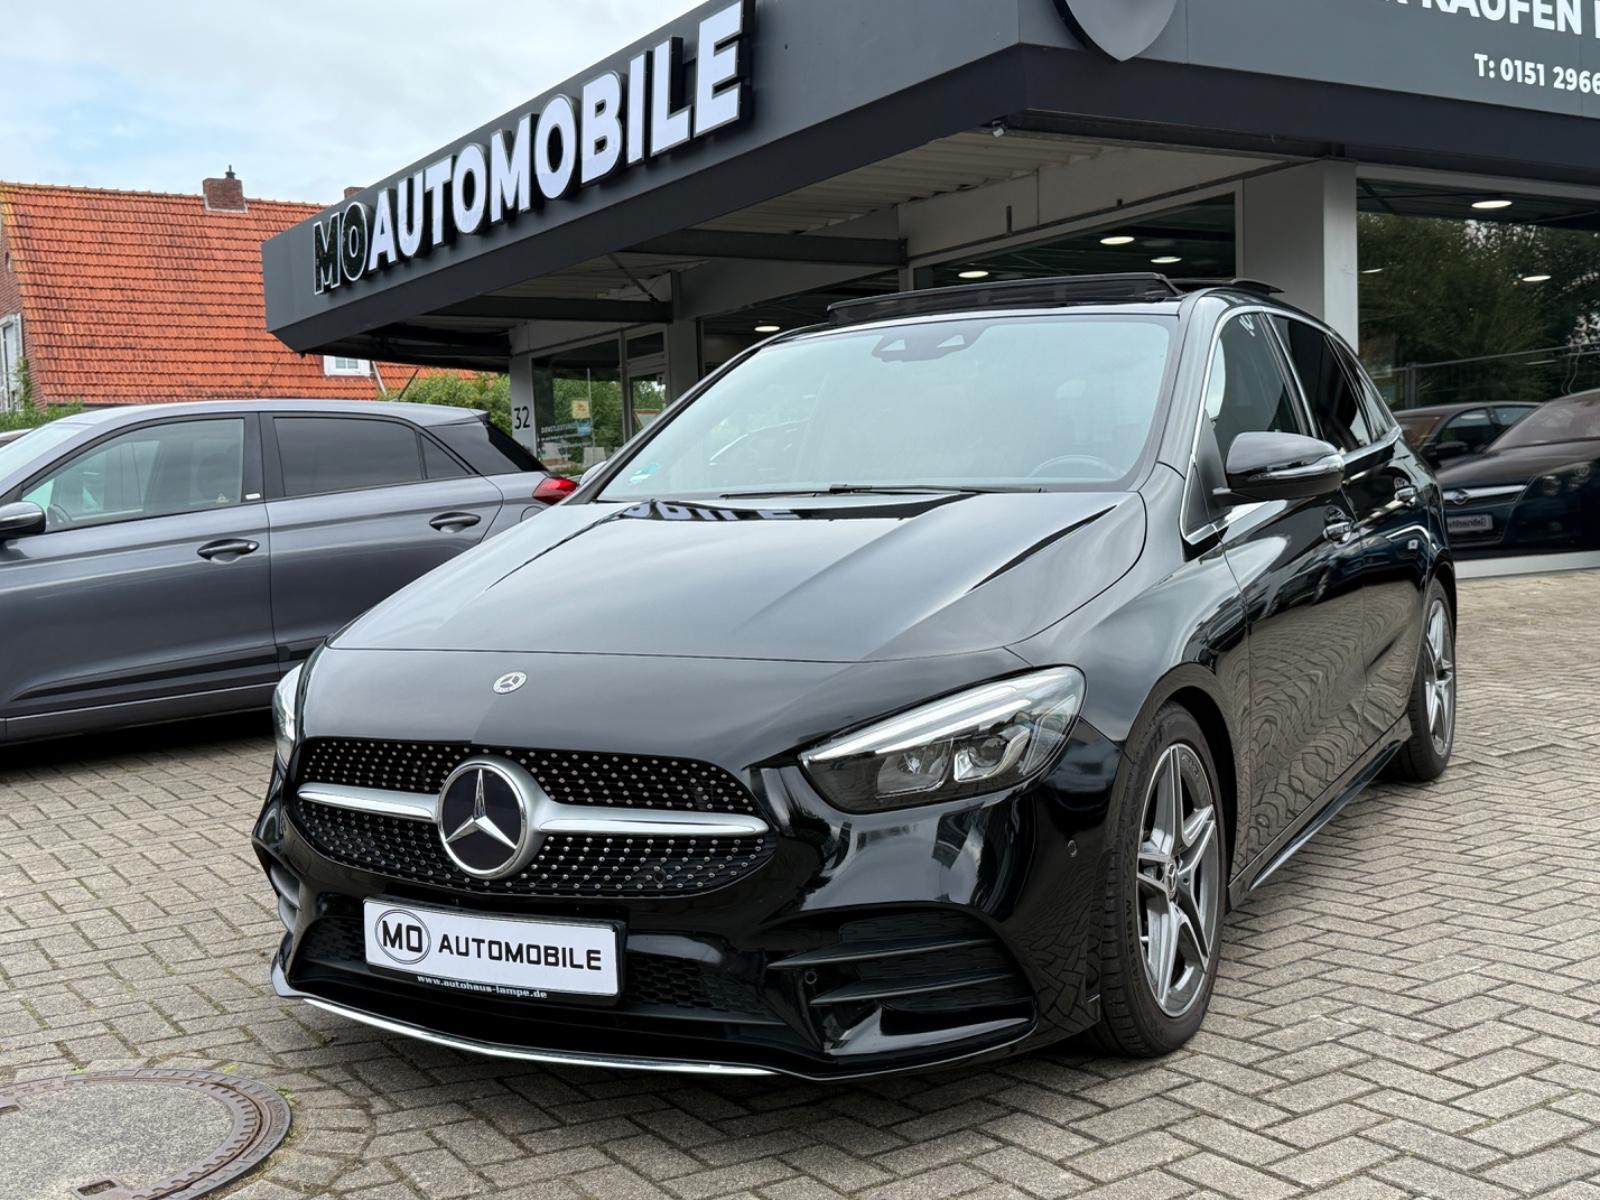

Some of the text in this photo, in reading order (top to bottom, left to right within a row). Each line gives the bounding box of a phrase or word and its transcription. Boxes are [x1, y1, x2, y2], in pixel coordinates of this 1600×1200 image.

[1500, 57, 1545, 86] 0151
[513, 405, 531, 430] 32
[381, 919, 602, 971] MO AUTOMOBILE
[416, 975, 548, 999] www.autohaus-lampe.de
